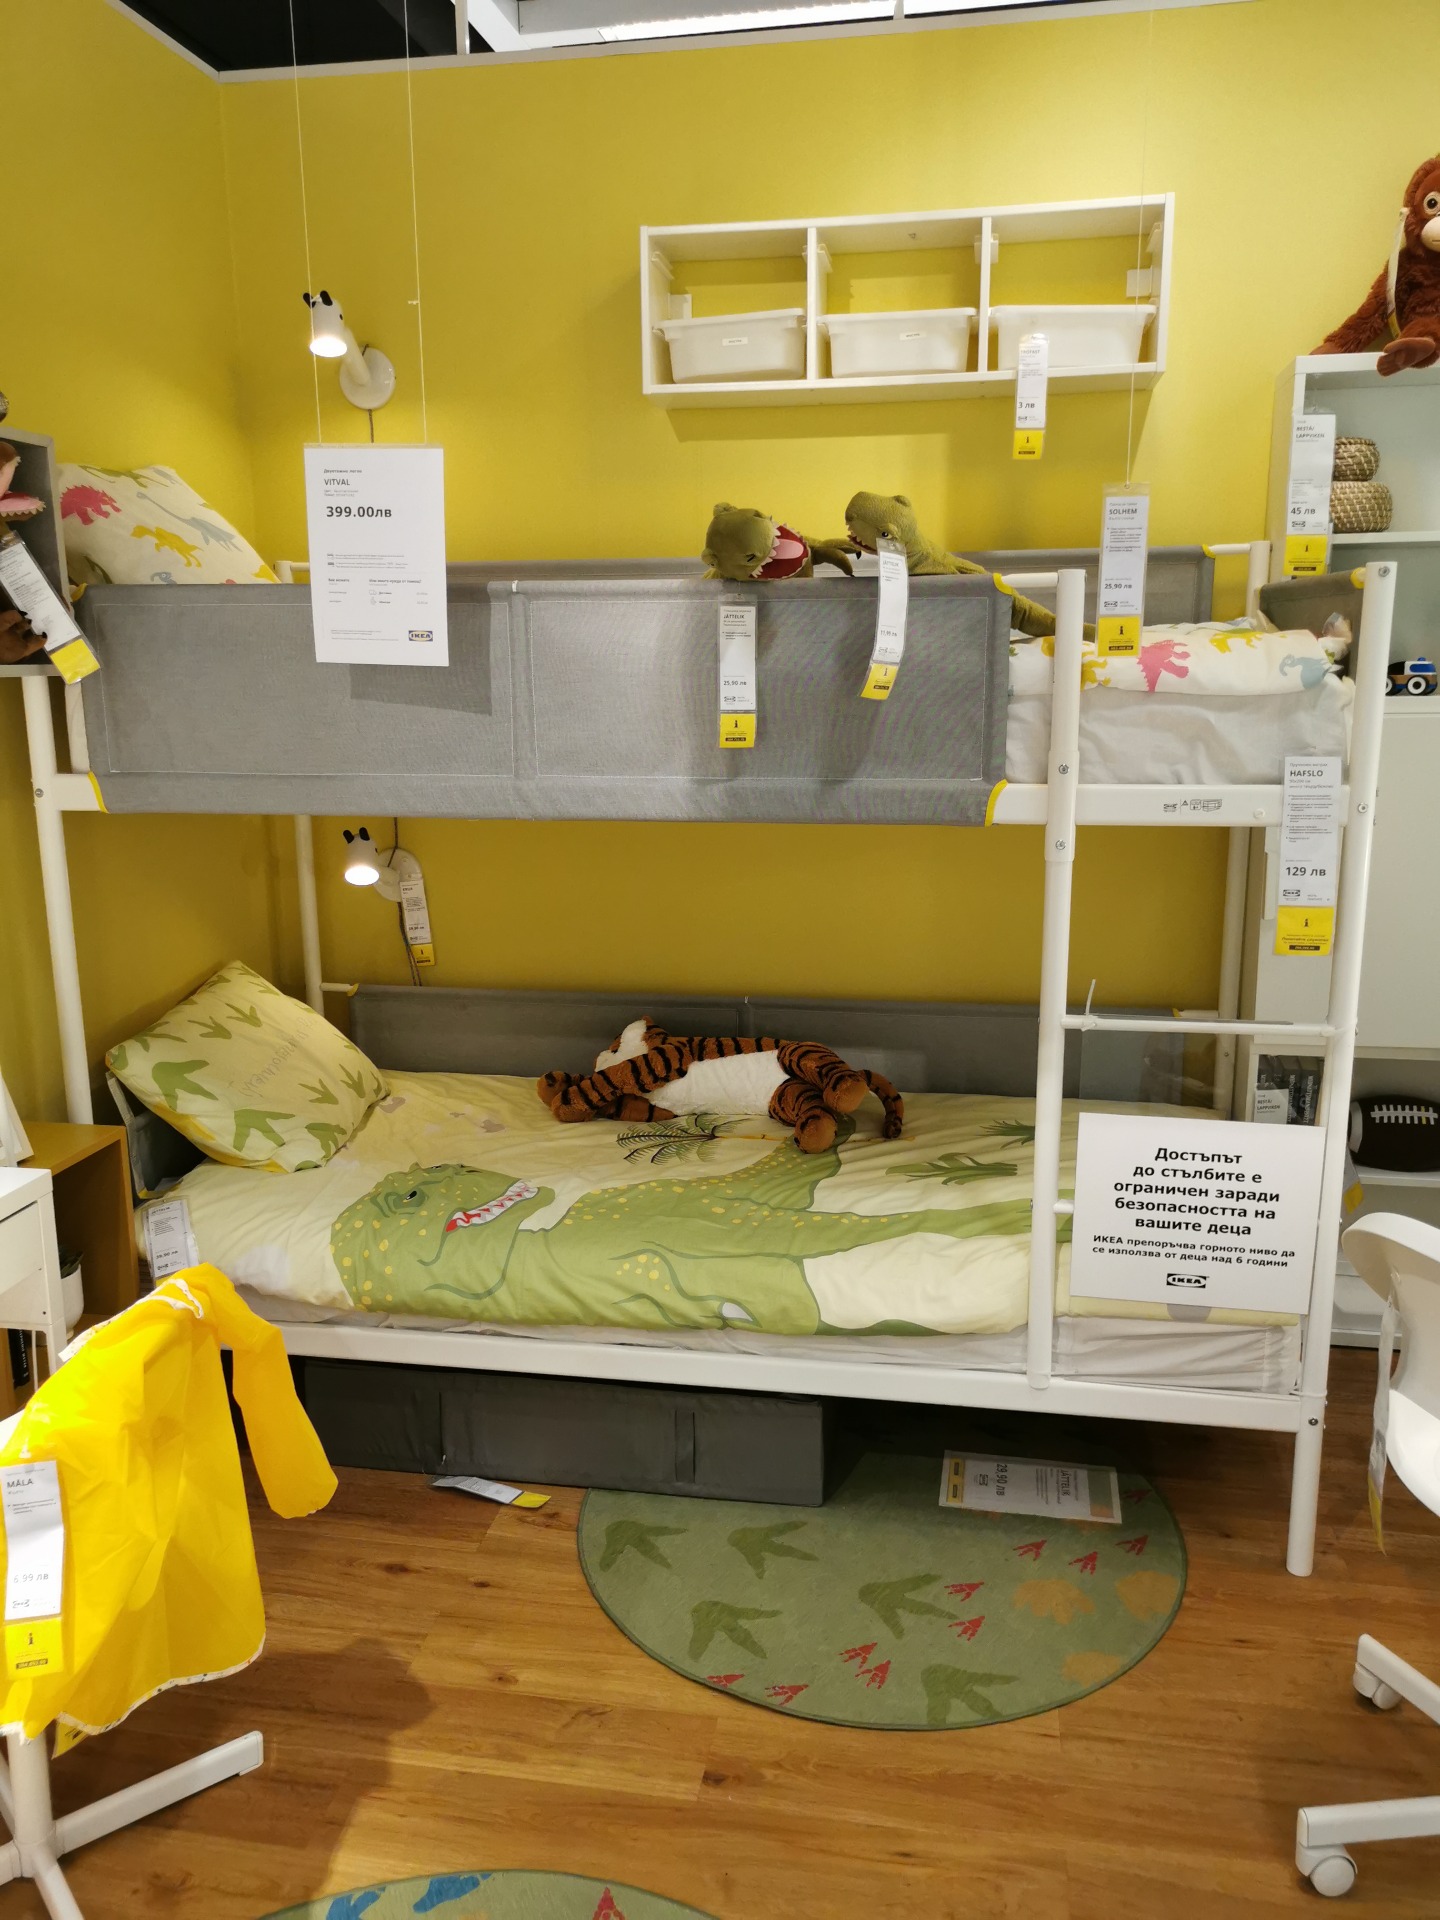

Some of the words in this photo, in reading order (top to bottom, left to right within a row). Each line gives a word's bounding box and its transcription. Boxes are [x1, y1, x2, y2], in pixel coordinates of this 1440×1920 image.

[326, 506, 392, 518] 399.00лв
[1290, 507, 1302, 515] 45
[1286, 867, 1307, 876] 129
[1310, 868, 1326, 877] лв
[1155, 1148, 1242, 1163] Достъпът
[1133, 1167, 1154, 1177] до
[1162, 1169, 1245, 1182] стълбите
[1252, 1174, 1261, 1183] е
[1114, 1183, 1208, 1197] ограничен
[1215, 1190, 1279, 1203] заради
[1115, 1198, 1247, 1217] безопасността
[1255, 1210, 1275, 1219] на
[1136, 1219, 1201, 1231] вашите
[1207, 1224, 1251, 1236] деца
[1094, 1235, 1123, 1243] ИКЕА
[1127, 1240, 1195, 1249] препоръчва
[1200, 1245, 1245, 1253] горното
[1109, 1249, 1160, 1257] използва
[1247, 1259, 1287, 1267] години
[996, 1463, 1008, 1484] 29,90
[7, 1478, 34, 1489] MÅLA
[996, 1484, 1006, 1496] лв
[36, 1573, 49, 1581] лв
